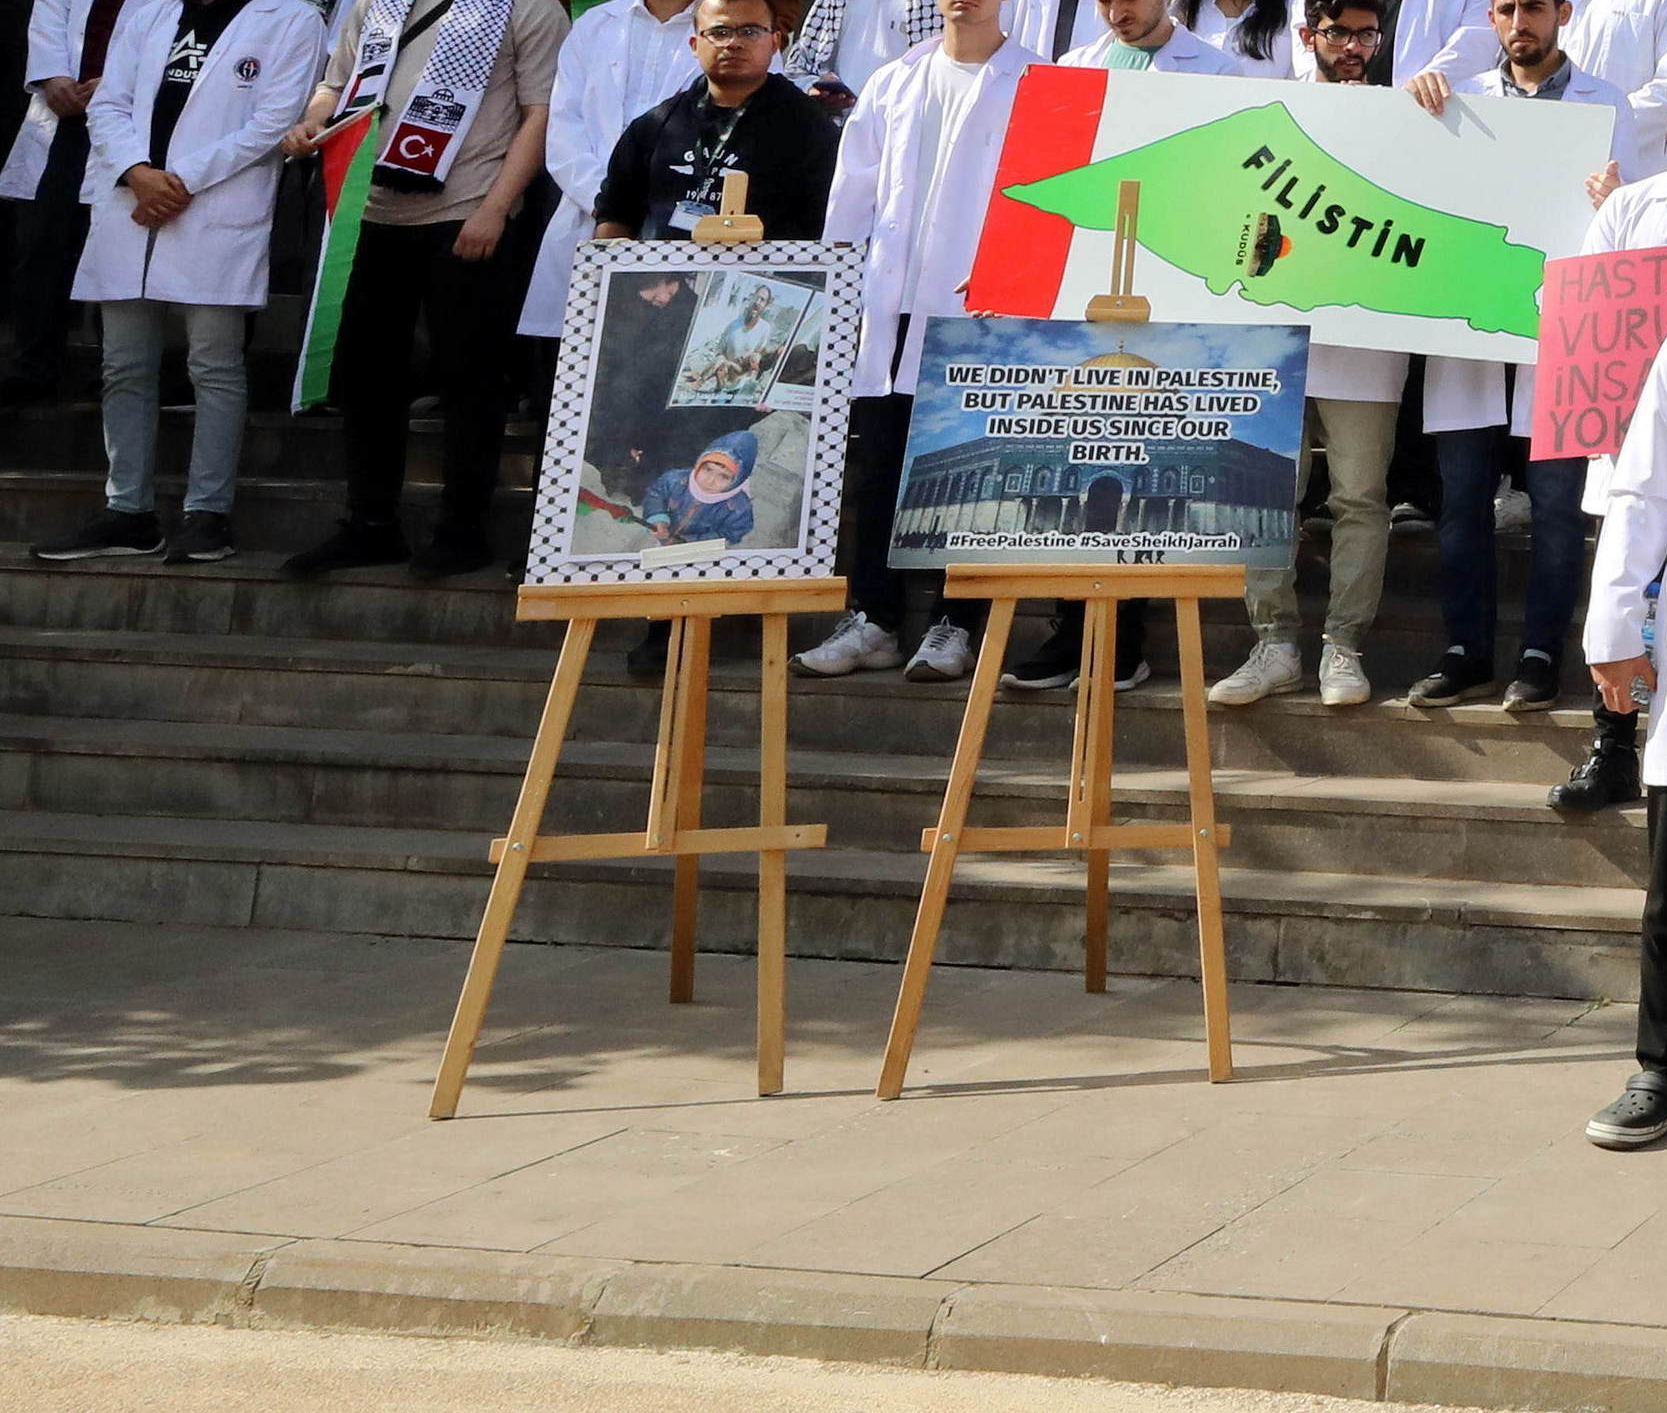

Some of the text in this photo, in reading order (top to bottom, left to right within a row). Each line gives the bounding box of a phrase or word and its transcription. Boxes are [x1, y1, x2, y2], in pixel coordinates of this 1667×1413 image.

[1241, 144, 1426, 268] FİLİSTİN
[948, 367, 1281, 391] WE DIDN'T LIVE IN PALESTINE,
[963, 394, 1258, 412] BUT PALESTINE HAS LIVED
[988, 419, 1228, 437] INSIDE US SINCE OUR
[1071, 444, 1147, 462] BIRTH.
[949, 534, 1238, 549] #FreePalestine #SaveSheikhJarrah
